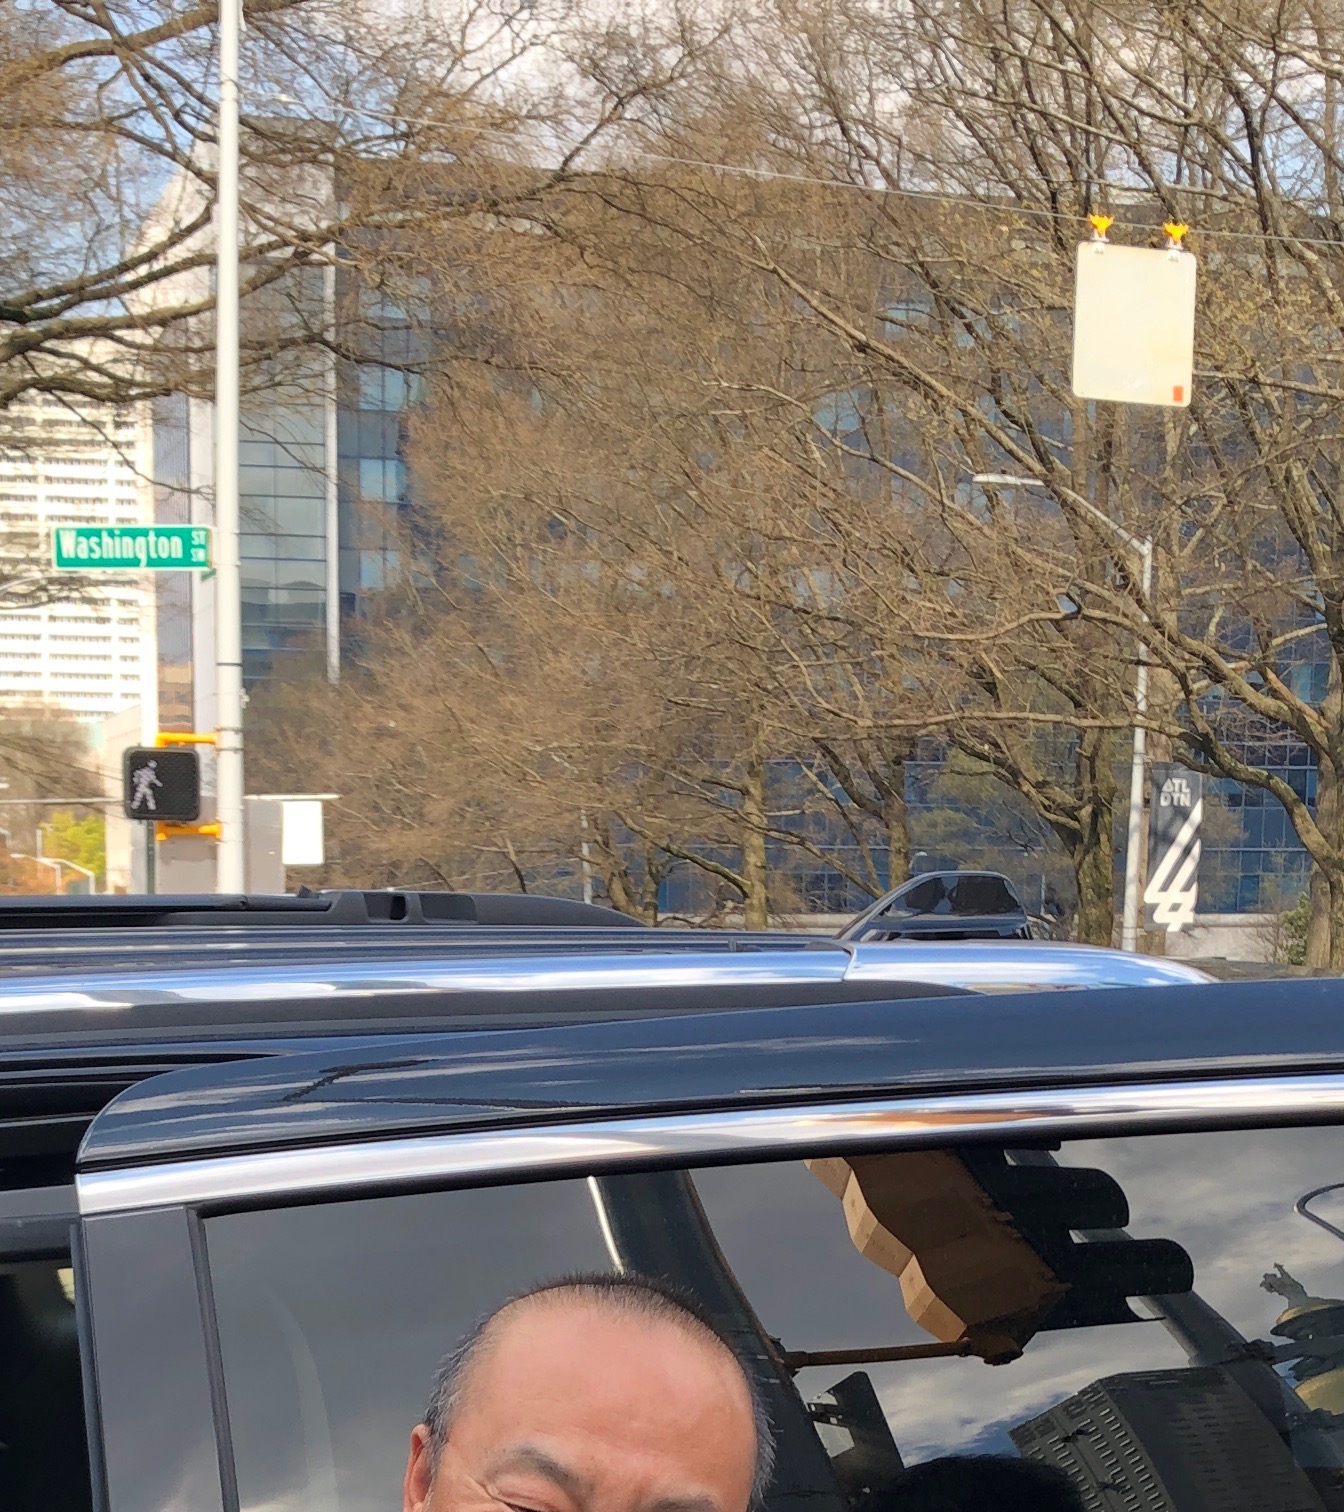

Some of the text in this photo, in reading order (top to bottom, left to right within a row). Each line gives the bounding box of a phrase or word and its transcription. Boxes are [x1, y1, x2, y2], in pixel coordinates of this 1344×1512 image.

[59, 529, 206, 568] Washington ST
[1160, 791, 1192, 807] DTN
